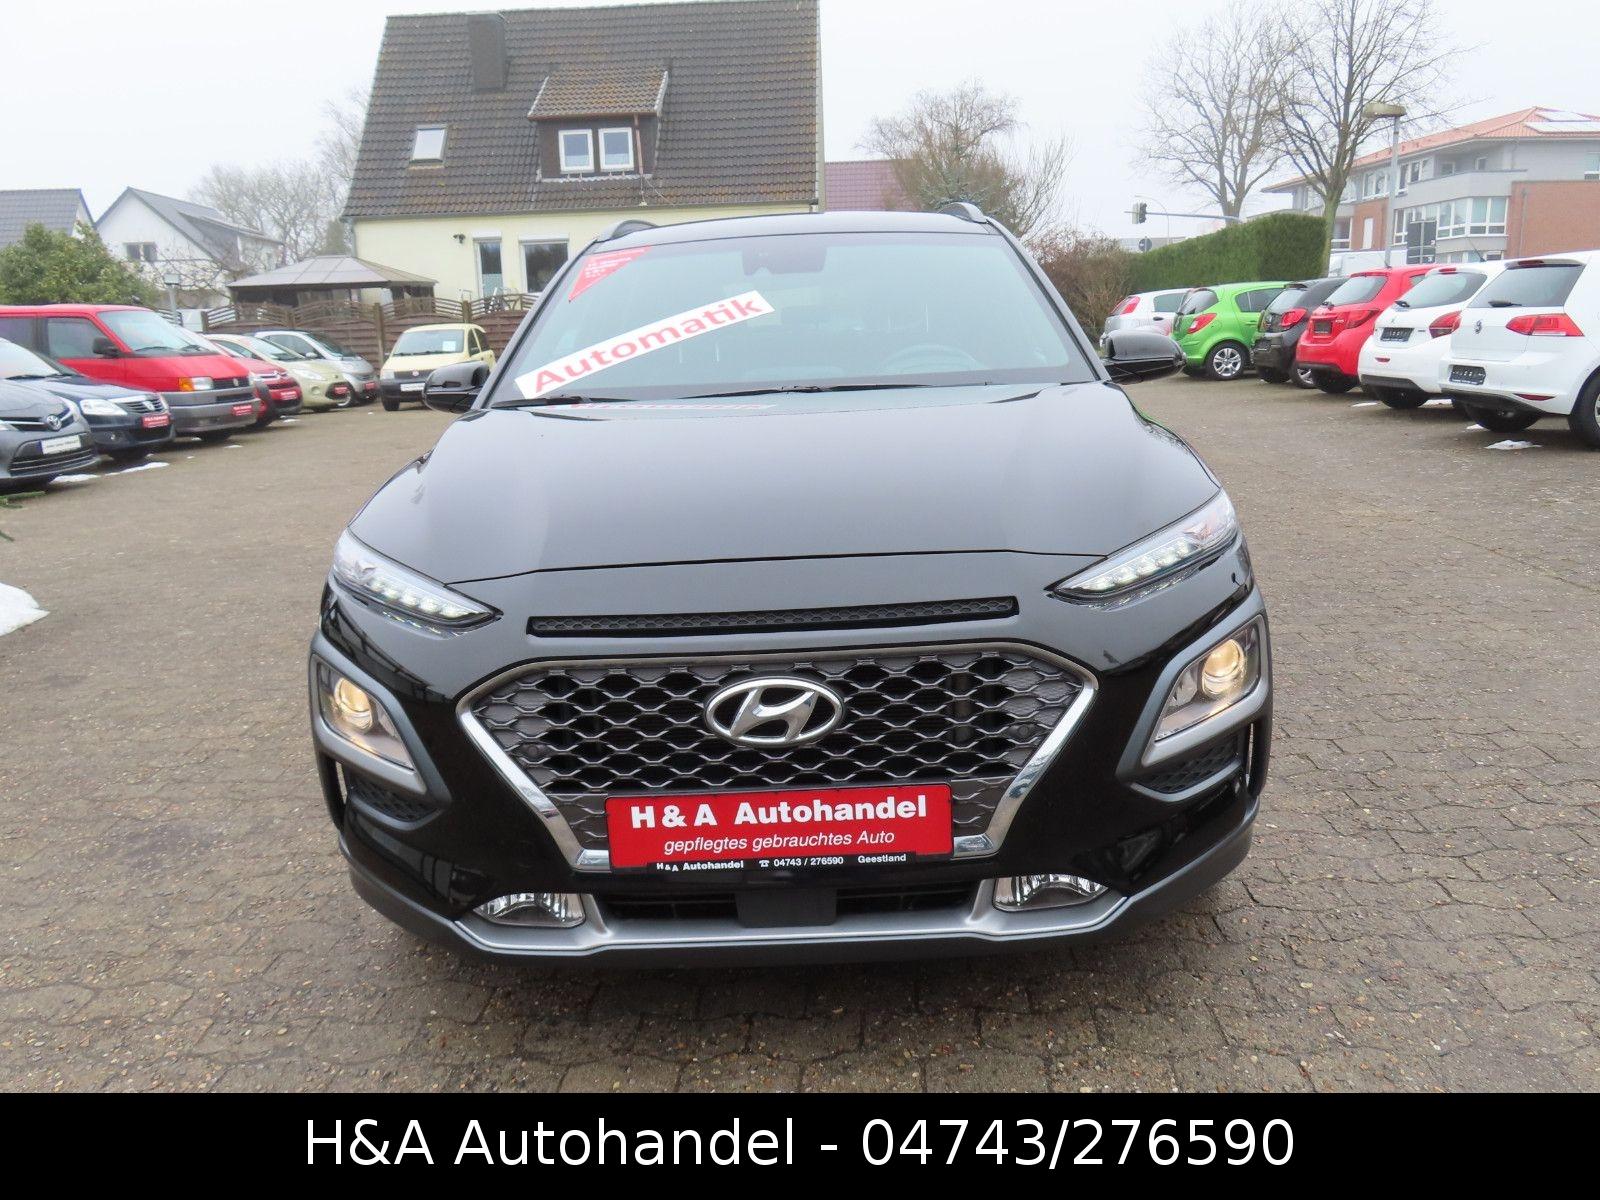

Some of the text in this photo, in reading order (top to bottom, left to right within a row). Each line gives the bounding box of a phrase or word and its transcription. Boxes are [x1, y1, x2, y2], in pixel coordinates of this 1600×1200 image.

[535, 298, 762, 393] Automatik
[734, 795, 927, 826] Autohandel
[664, 830, 895, 855] gepflegtes gebrauchtes Auto
[682, 860, 744, 871] Autohandel
[810, 856, 844, 866] 276590
[858, 853, 907, 864] Geestland
